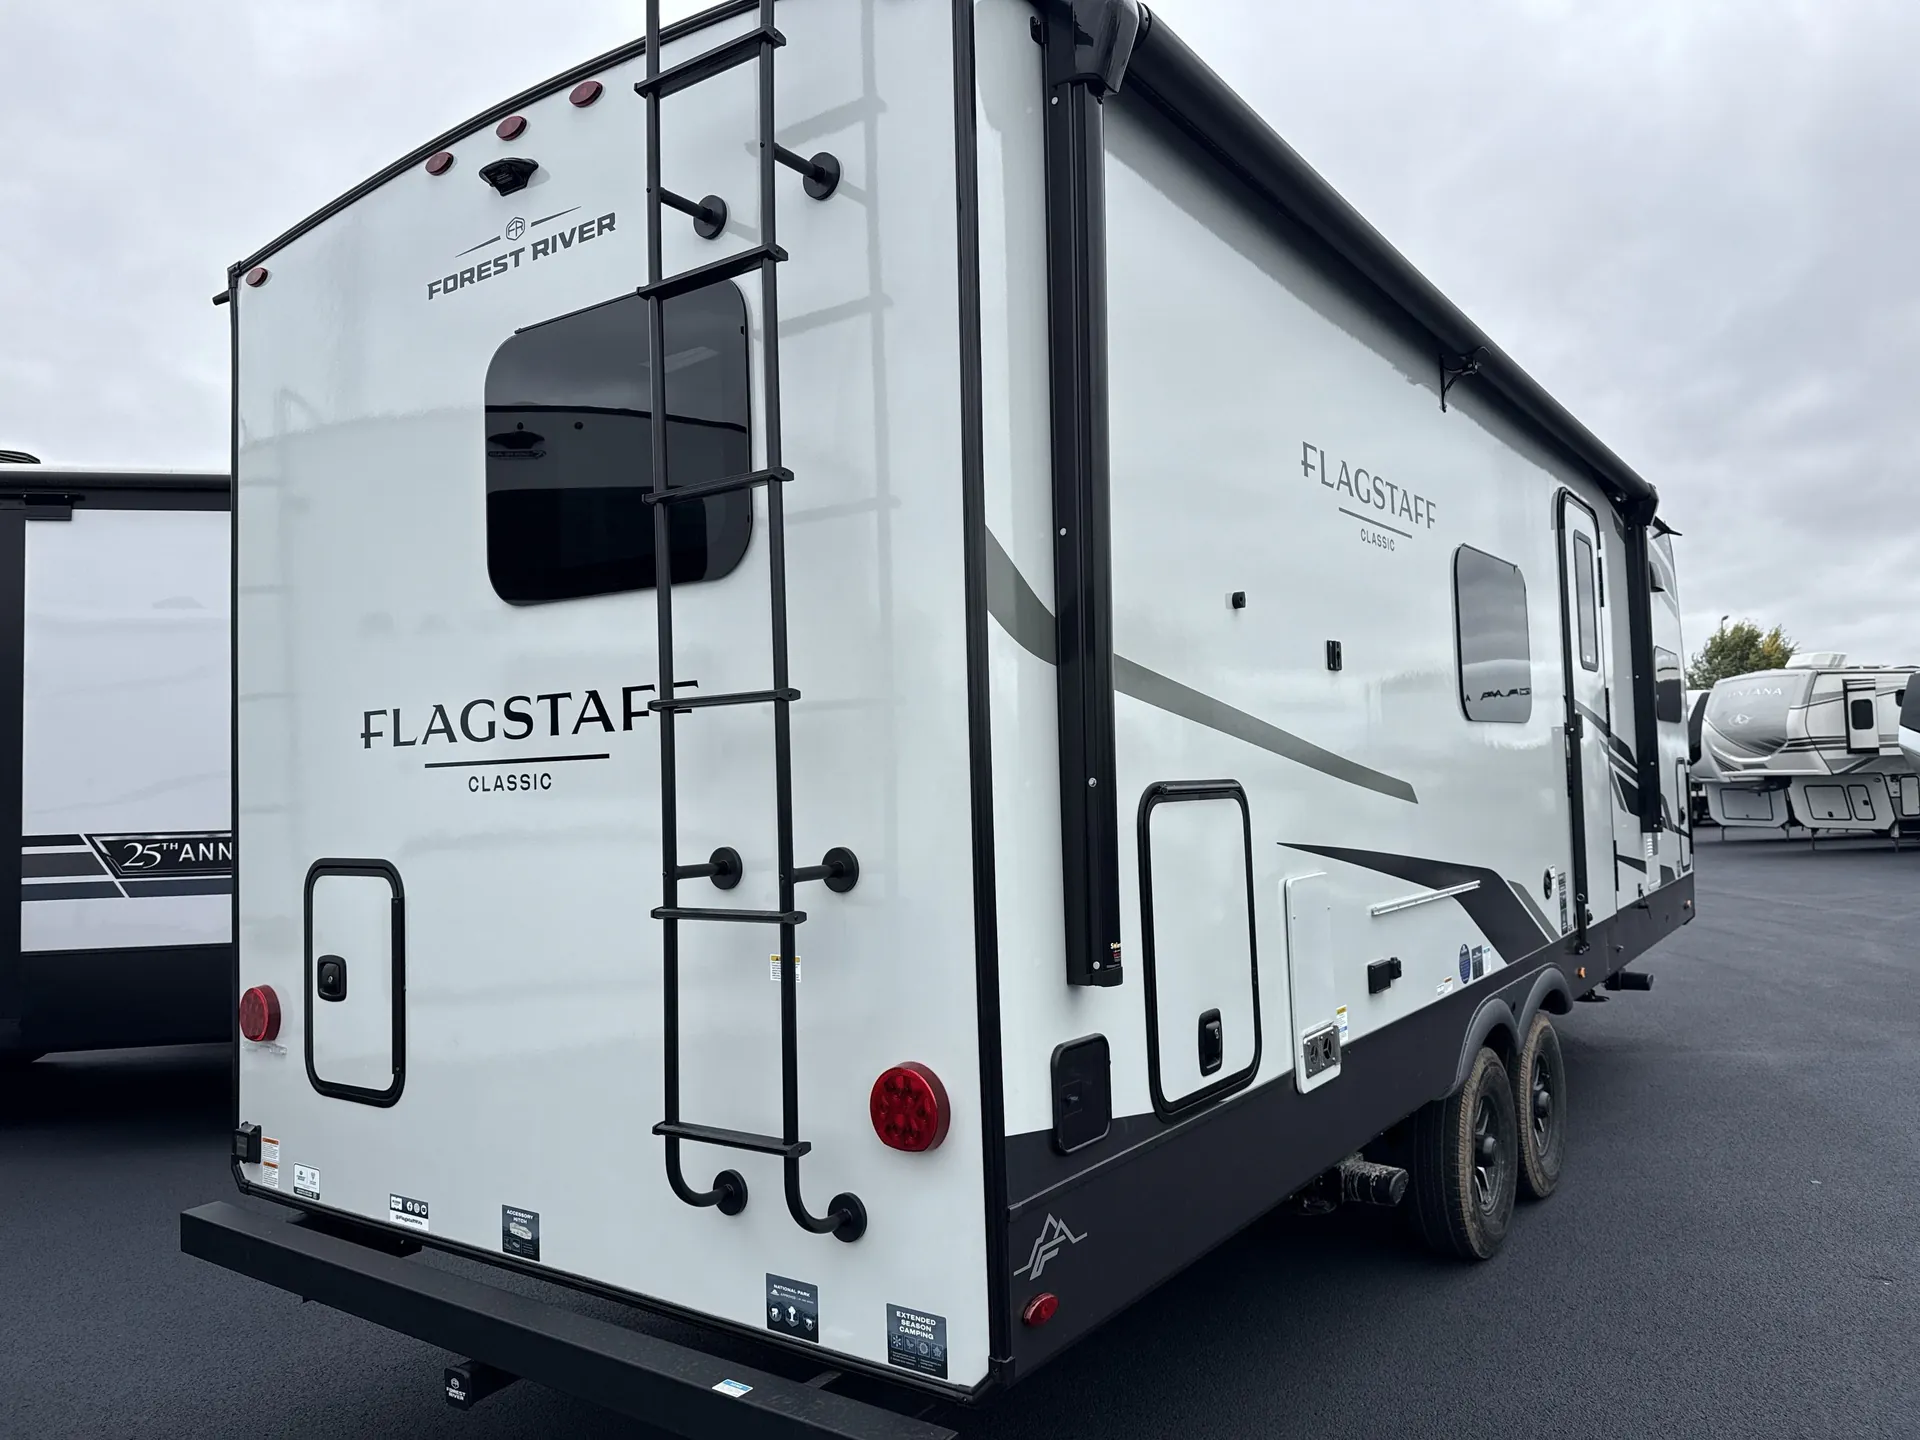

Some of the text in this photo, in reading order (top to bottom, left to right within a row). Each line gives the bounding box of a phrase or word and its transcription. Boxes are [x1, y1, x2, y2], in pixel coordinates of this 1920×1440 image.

[427, 212, 617, 300] FOREST RIVER
[1300, 441, 1437, 529] FLAGSTAFF
[1360, 528, 1395, 552] CLASSIC
[468, 772, 552, 793] CLASSIC
[121, 842, 233, 869] 25TH ANN
[506, 1209, 534, 1220] ACCESSORY
[513, 1216, 528, 1225] HITCH
[773, 1283, 811, 1298] NATIONAL PARK
[896, 1310, 936, 1326] EXTENDED
[900, 1319, 932, 1332] SEASON
[899, 1325, 934, 1340] CAMPING
